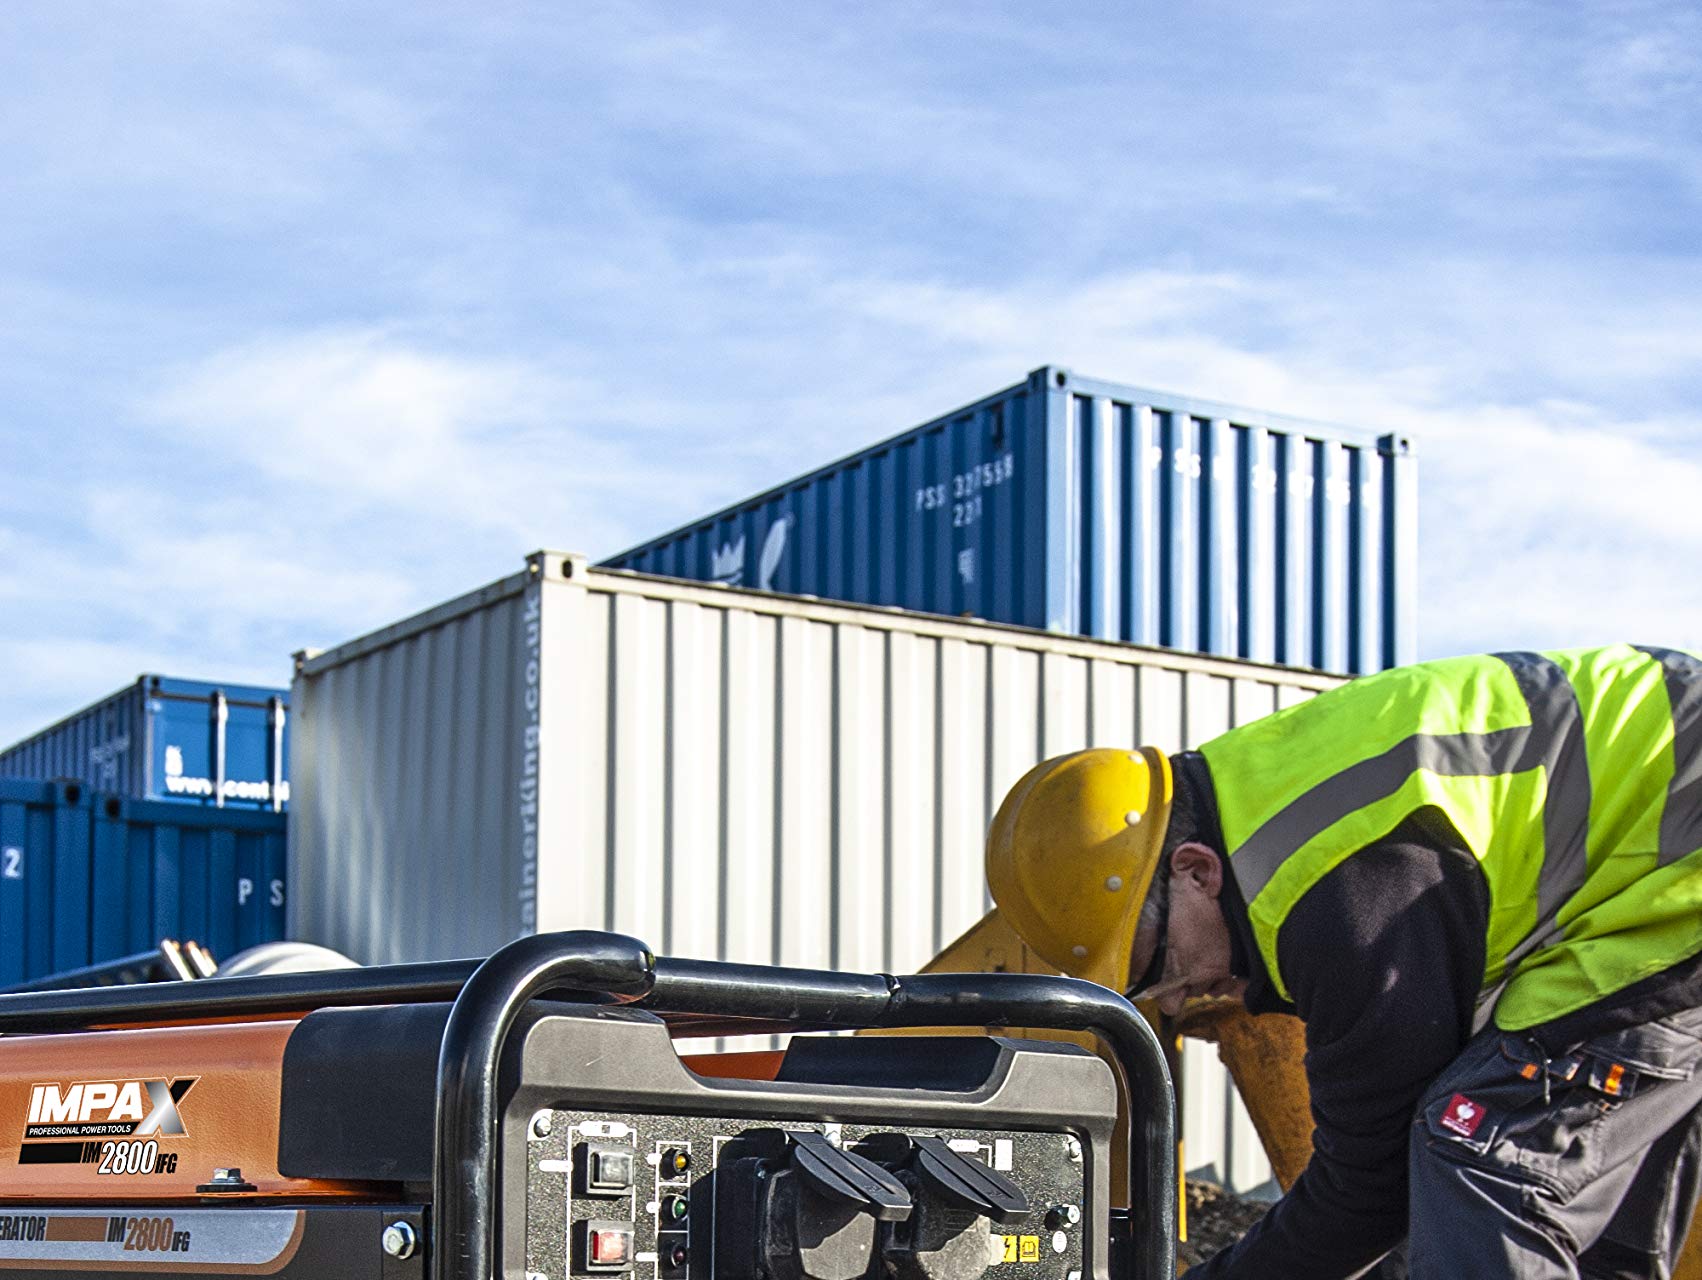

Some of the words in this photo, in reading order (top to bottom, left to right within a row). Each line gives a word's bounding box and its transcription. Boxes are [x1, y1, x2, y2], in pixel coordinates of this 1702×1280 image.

[5, 849, 20, 877] 2
[238, 878, 253, 906] P
[28, 1079, 196, 1135] IMPAX
[29, 1127, 80, 1135] PROFESSIONAL
[107, 1125, 131, 1133] TOOLS
